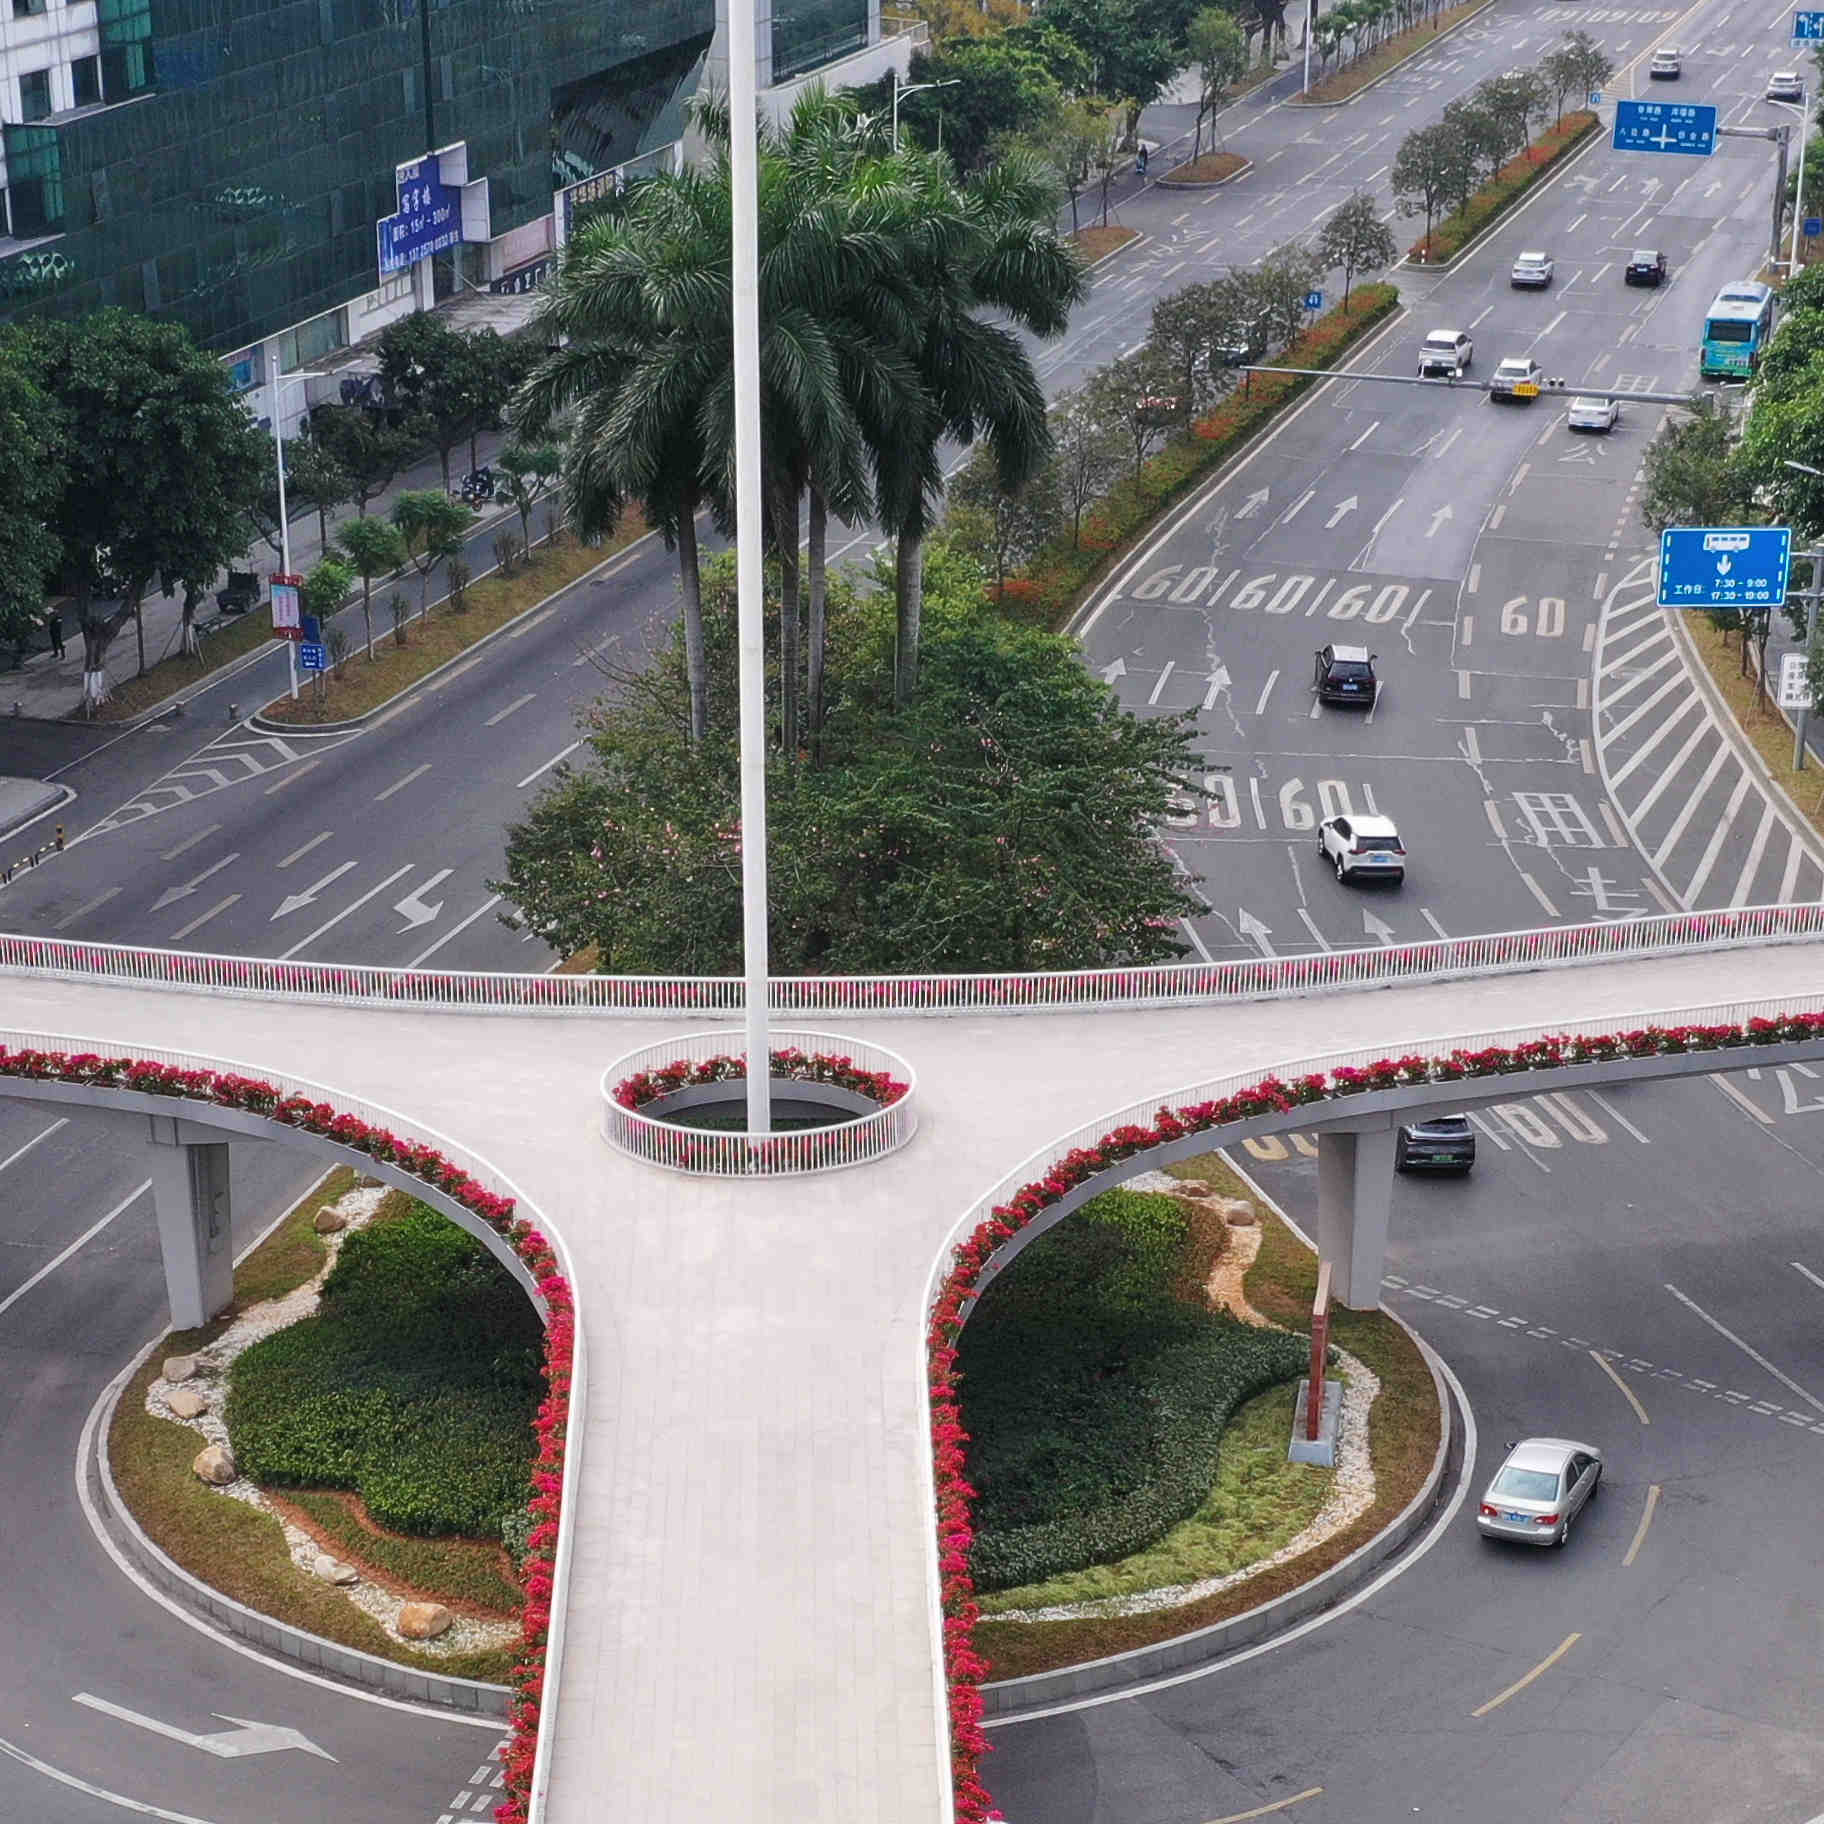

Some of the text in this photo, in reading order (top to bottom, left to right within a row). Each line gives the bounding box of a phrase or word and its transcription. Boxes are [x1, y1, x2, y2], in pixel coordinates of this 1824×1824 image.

[1131, 564, 1410, 623] 60 60 60
[1501, 596, 1565, 638] 60
